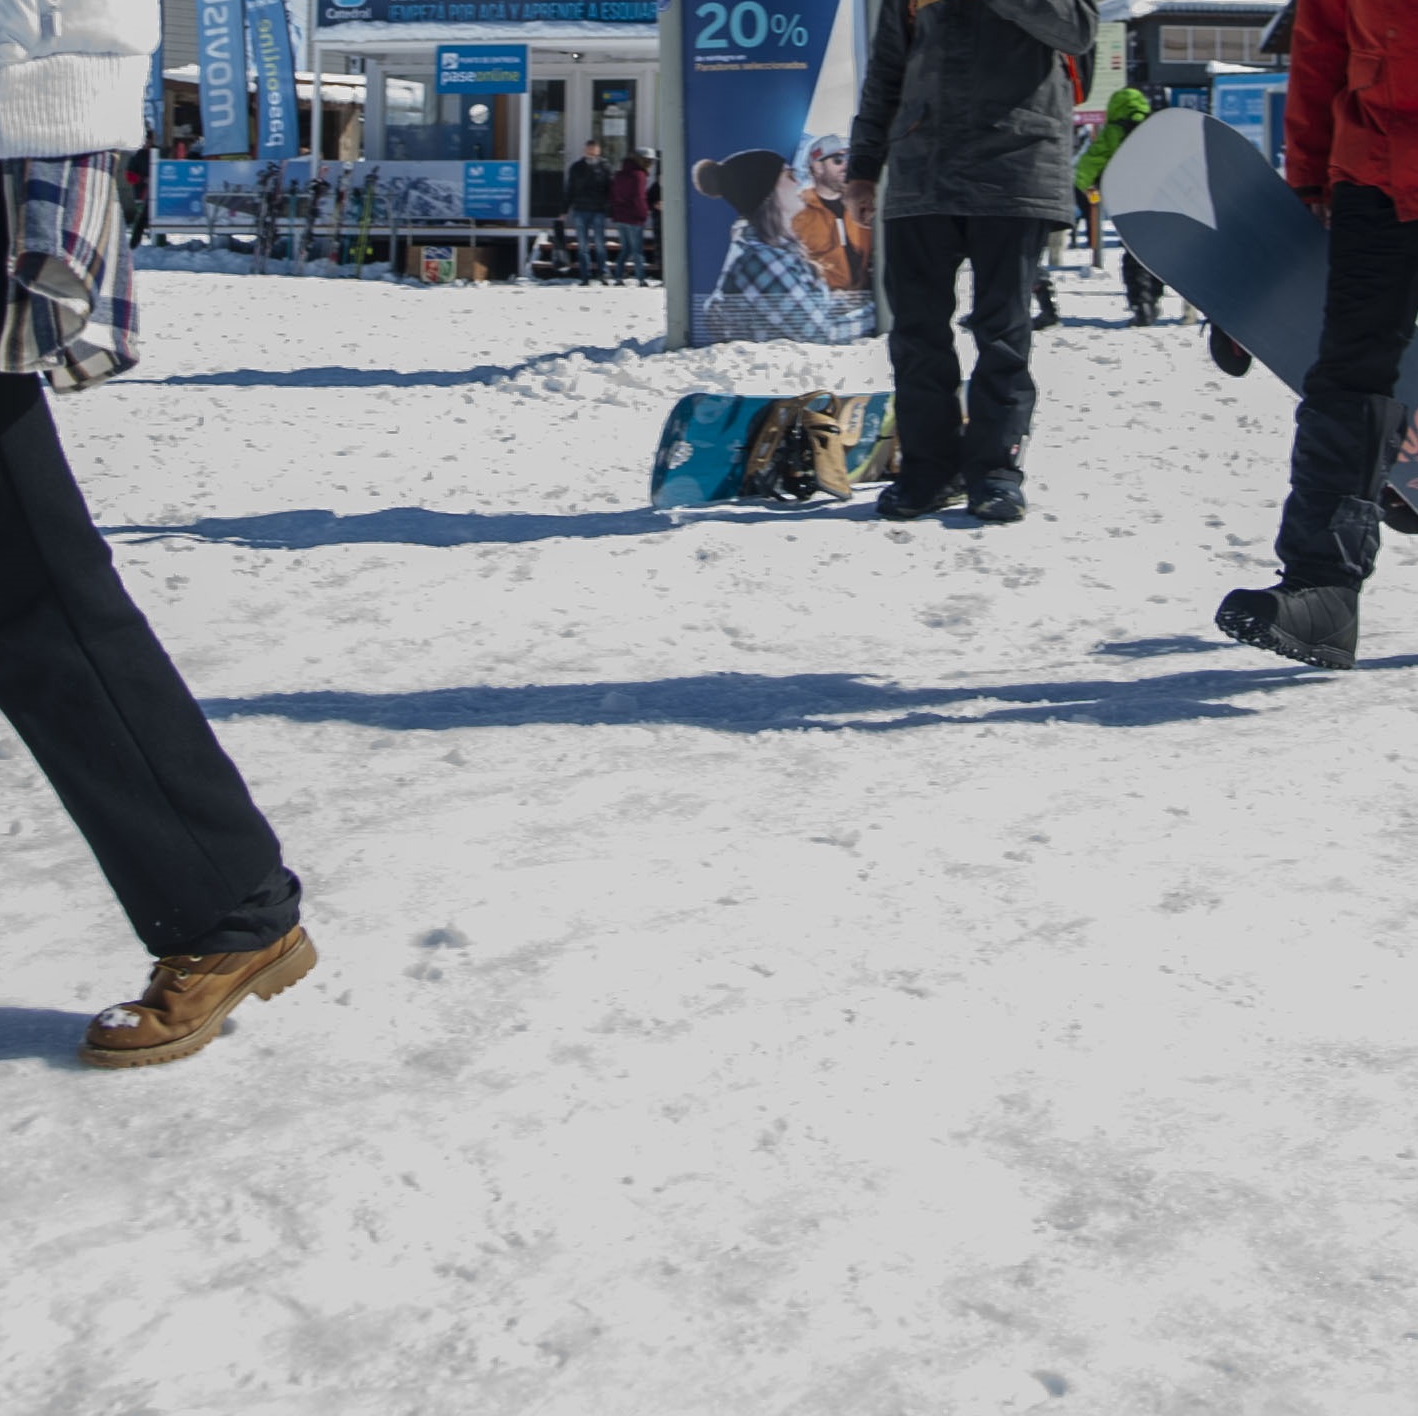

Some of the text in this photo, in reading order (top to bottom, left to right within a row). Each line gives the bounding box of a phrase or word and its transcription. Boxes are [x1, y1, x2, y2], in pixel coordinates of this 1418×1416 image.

[325, 7, 373, 19] Catedral
[449, 4, 475, 20] POR
[508, 3, 519, 20] Y
[587, 2, 599, 19] A
[695, 0, 809, 49] 20%
